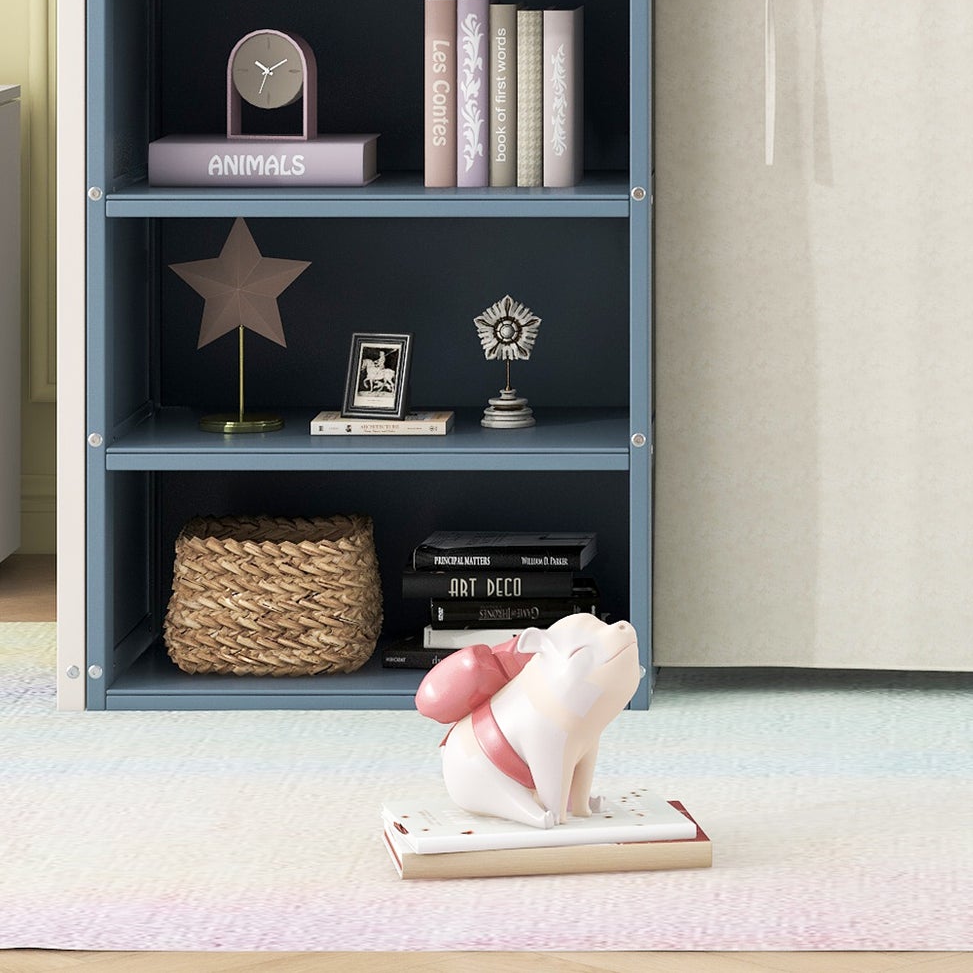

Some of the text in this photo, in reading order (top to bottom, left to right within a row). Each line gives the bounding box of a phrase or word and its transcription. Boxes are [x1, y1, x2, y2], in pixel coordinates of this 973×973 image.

[432, 39, 451, 148] Les Contes
[495, 27, 506, 162] book of first words
[208, 154, 305, 176] ANIMALS
[434, 556, 491, 566] PRINCIPAL MATTERS
[448, 577, 522, 597] ART DECO
